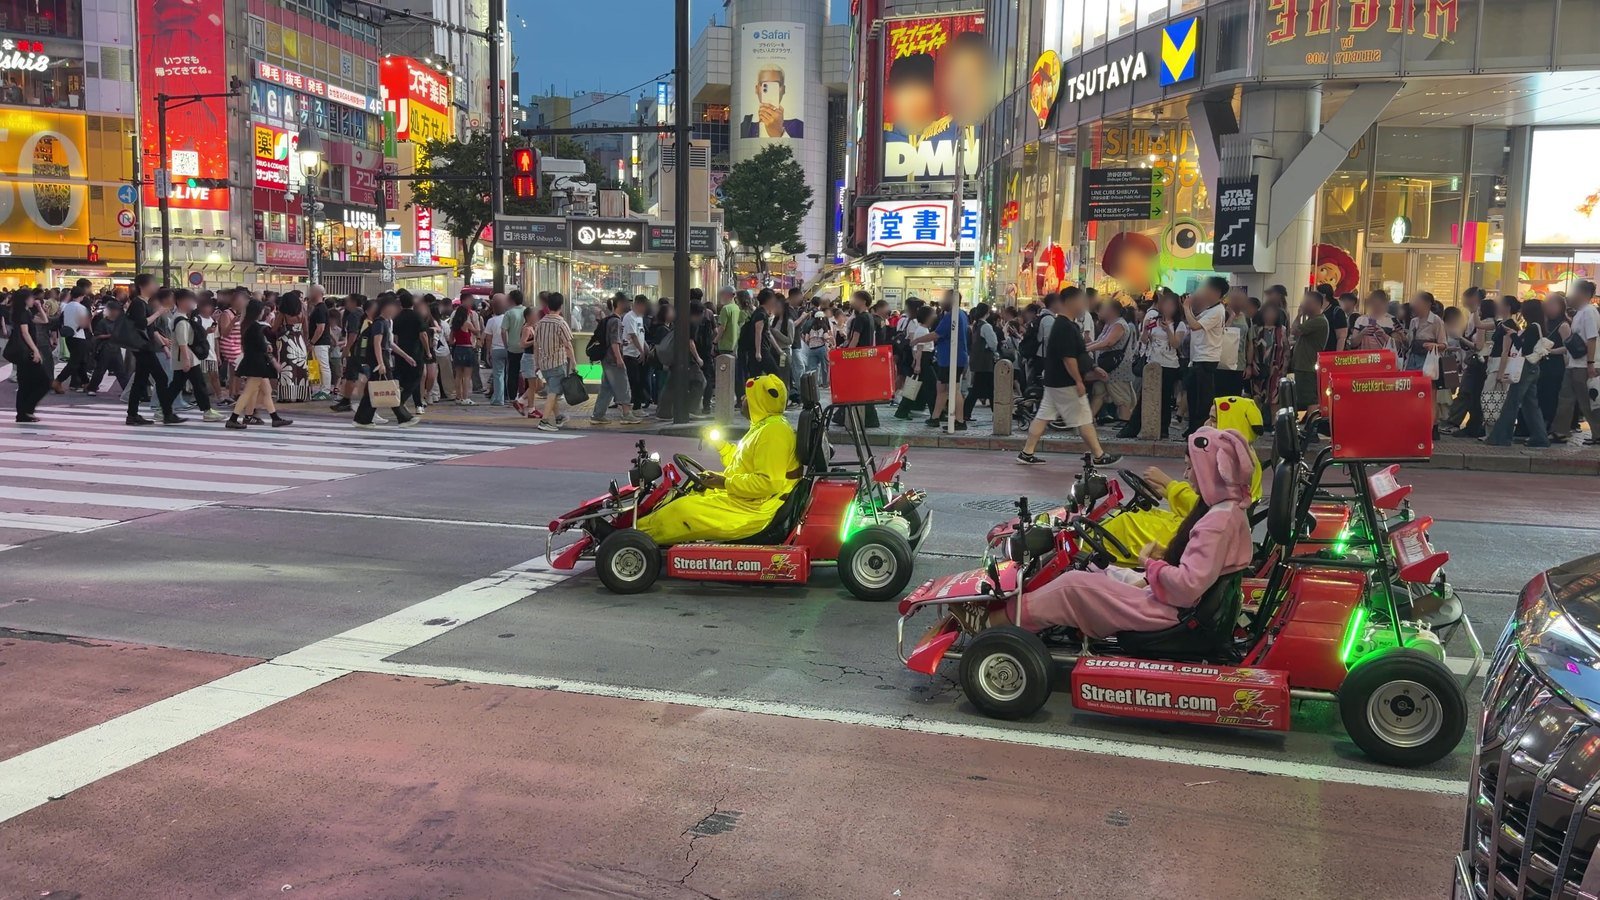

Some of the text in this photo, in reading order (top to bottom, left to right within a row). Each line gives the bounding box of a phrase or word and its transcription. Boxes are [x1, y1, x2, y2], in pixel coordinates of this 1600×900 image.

[761, 30, 790, 39] Safari
[0, 51, 49, 72] shi8
[163, 55, 200, 65] いつでも
[154, 65, 213, 77] 帰ってきてね。
[1067, 51, 1148, 103] TSUTAYA
[409, 68, 448, 109] スギ薬局
[257, 130, 272, 156] 薬
[1221, 189, 1253, 198] STAR
[1220, 197, 1253, 207] WARS
[343, 209, 377, 231] LUSH
[597, 228, 637, 240] しぶちか
[1221, 243, 1246, 258] B1F
[674, 557, 761, 571] Street Kart .com
[1085, 660, 1136, 668] Street
[1138, 662, 1174, 671] Kart
[1177, 666, 1219, 675] .com
[1081, 684, 1217, 712] Street Kart .com
